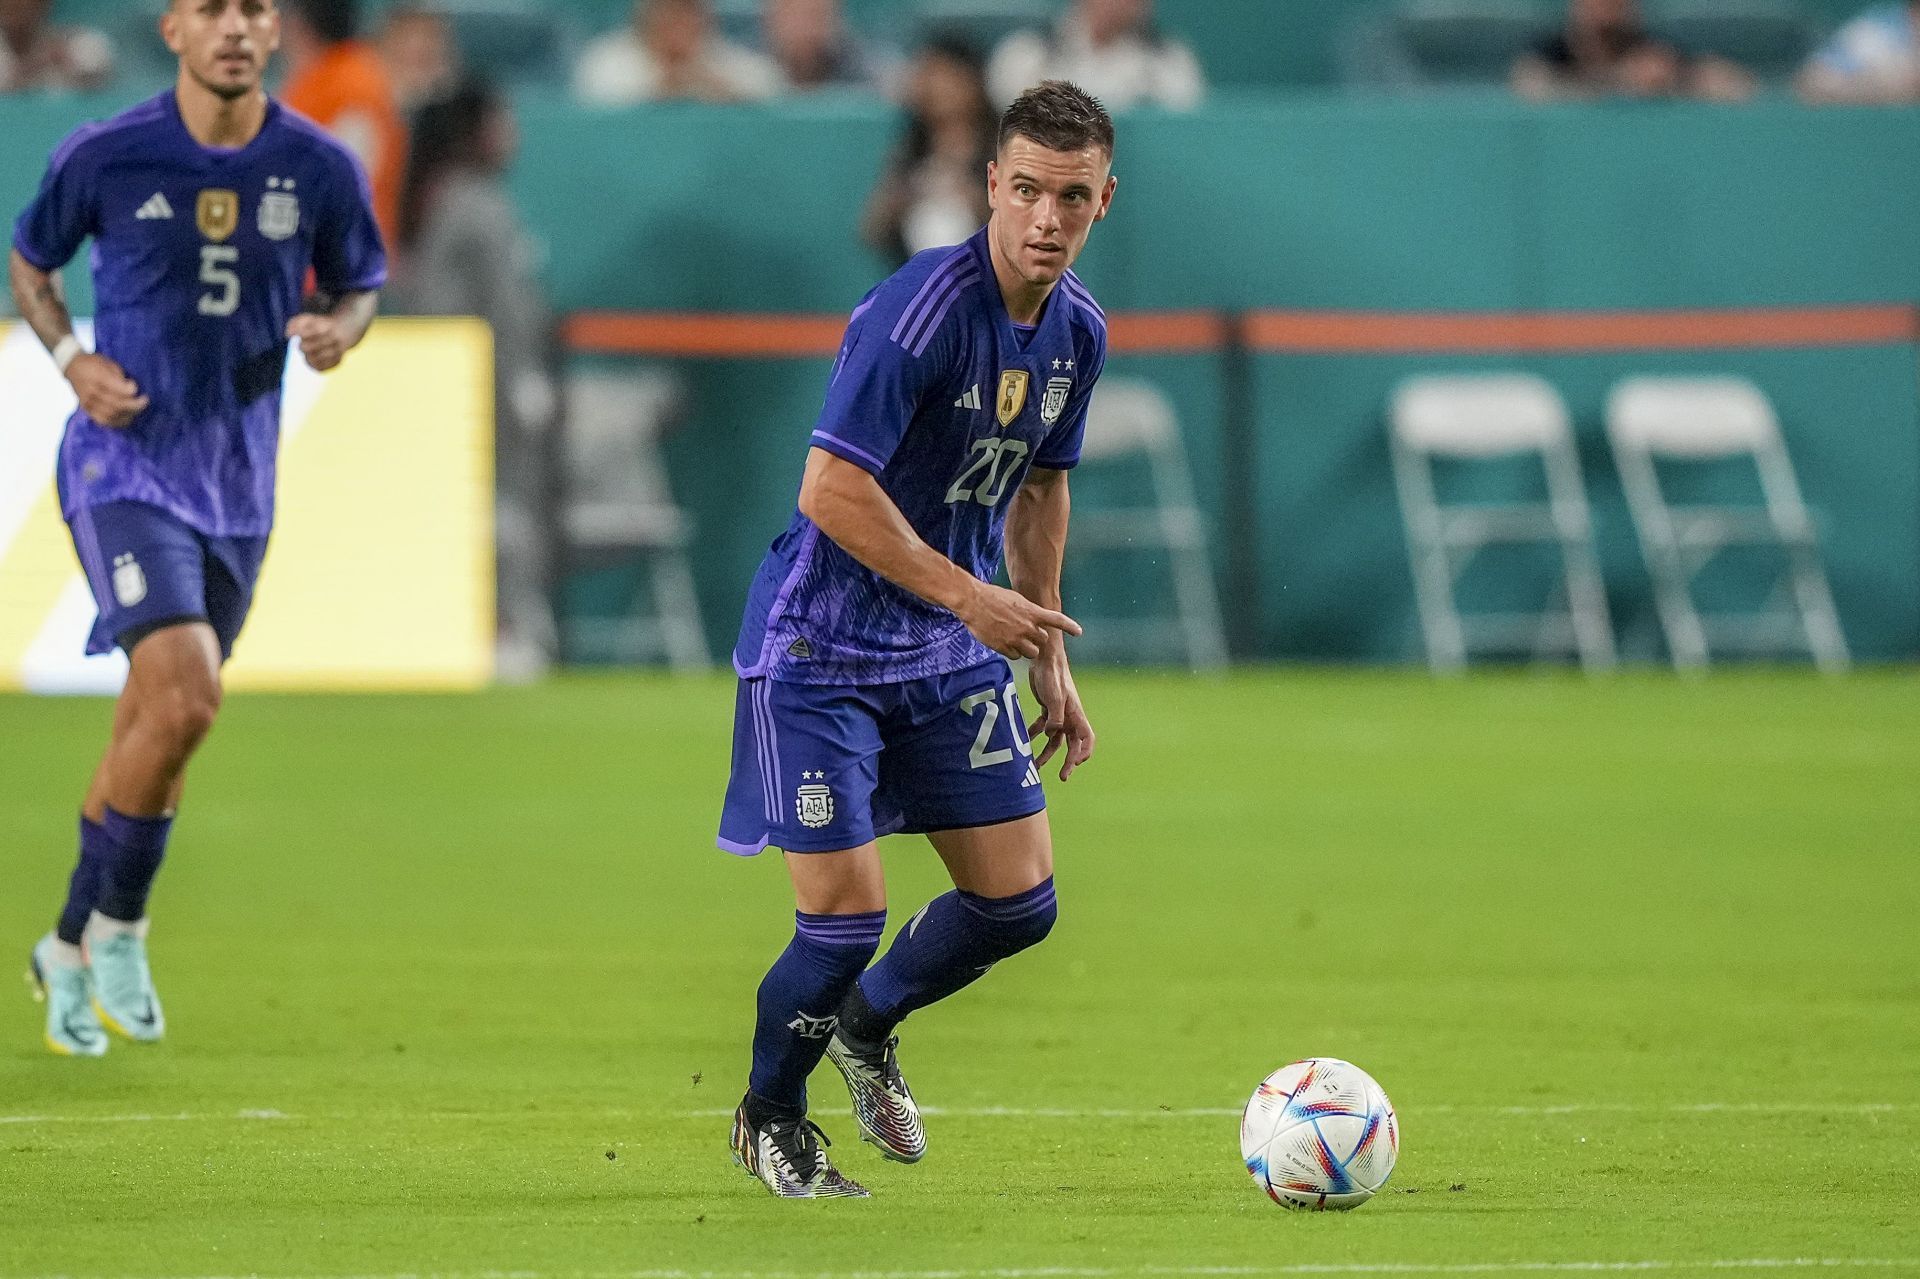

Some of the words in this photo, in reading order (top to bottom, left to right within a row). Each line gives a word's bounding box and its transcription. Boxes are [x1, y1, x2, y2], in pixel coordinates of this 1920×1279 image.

[197, 245, 242, 316] 5
[943, 437, 1029, 507] 20
[960, 682, 1032, 769] 20
[805, 796, 825, 817] AFA
